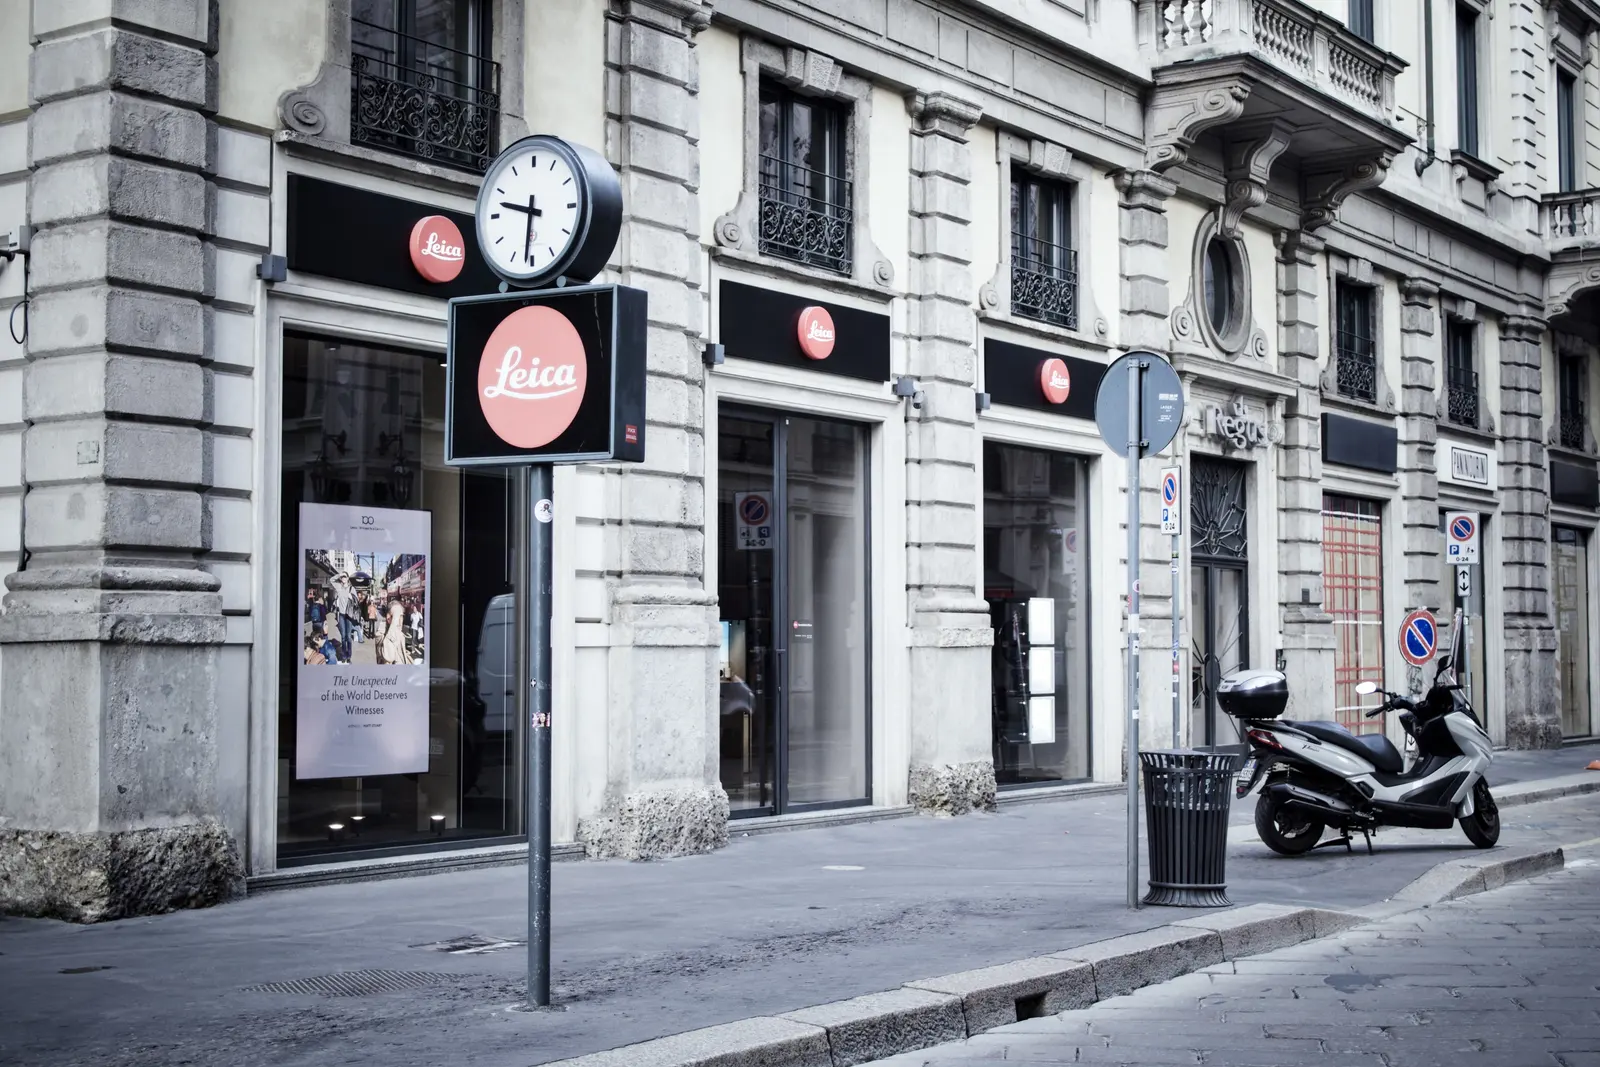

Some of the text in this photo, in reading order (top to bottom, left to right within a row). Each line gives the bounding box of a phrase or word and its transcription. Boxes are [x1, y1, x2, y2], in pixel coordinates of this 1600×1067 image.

[421, 232, 462, 261] Leica
[807, 320, 833, 342] Leica
[484, 346, 577, 399] Leica
[1049, 370, 1069, 389] Leica
[1207, 405, 1269, 449] Regus
[1451, 545, 1458, 554] P
[333, 675, 398, 688] The Unexpected
[321, 689, 408, 701] of the World Deserves
[345, 704, 384, 715] Witnesses
